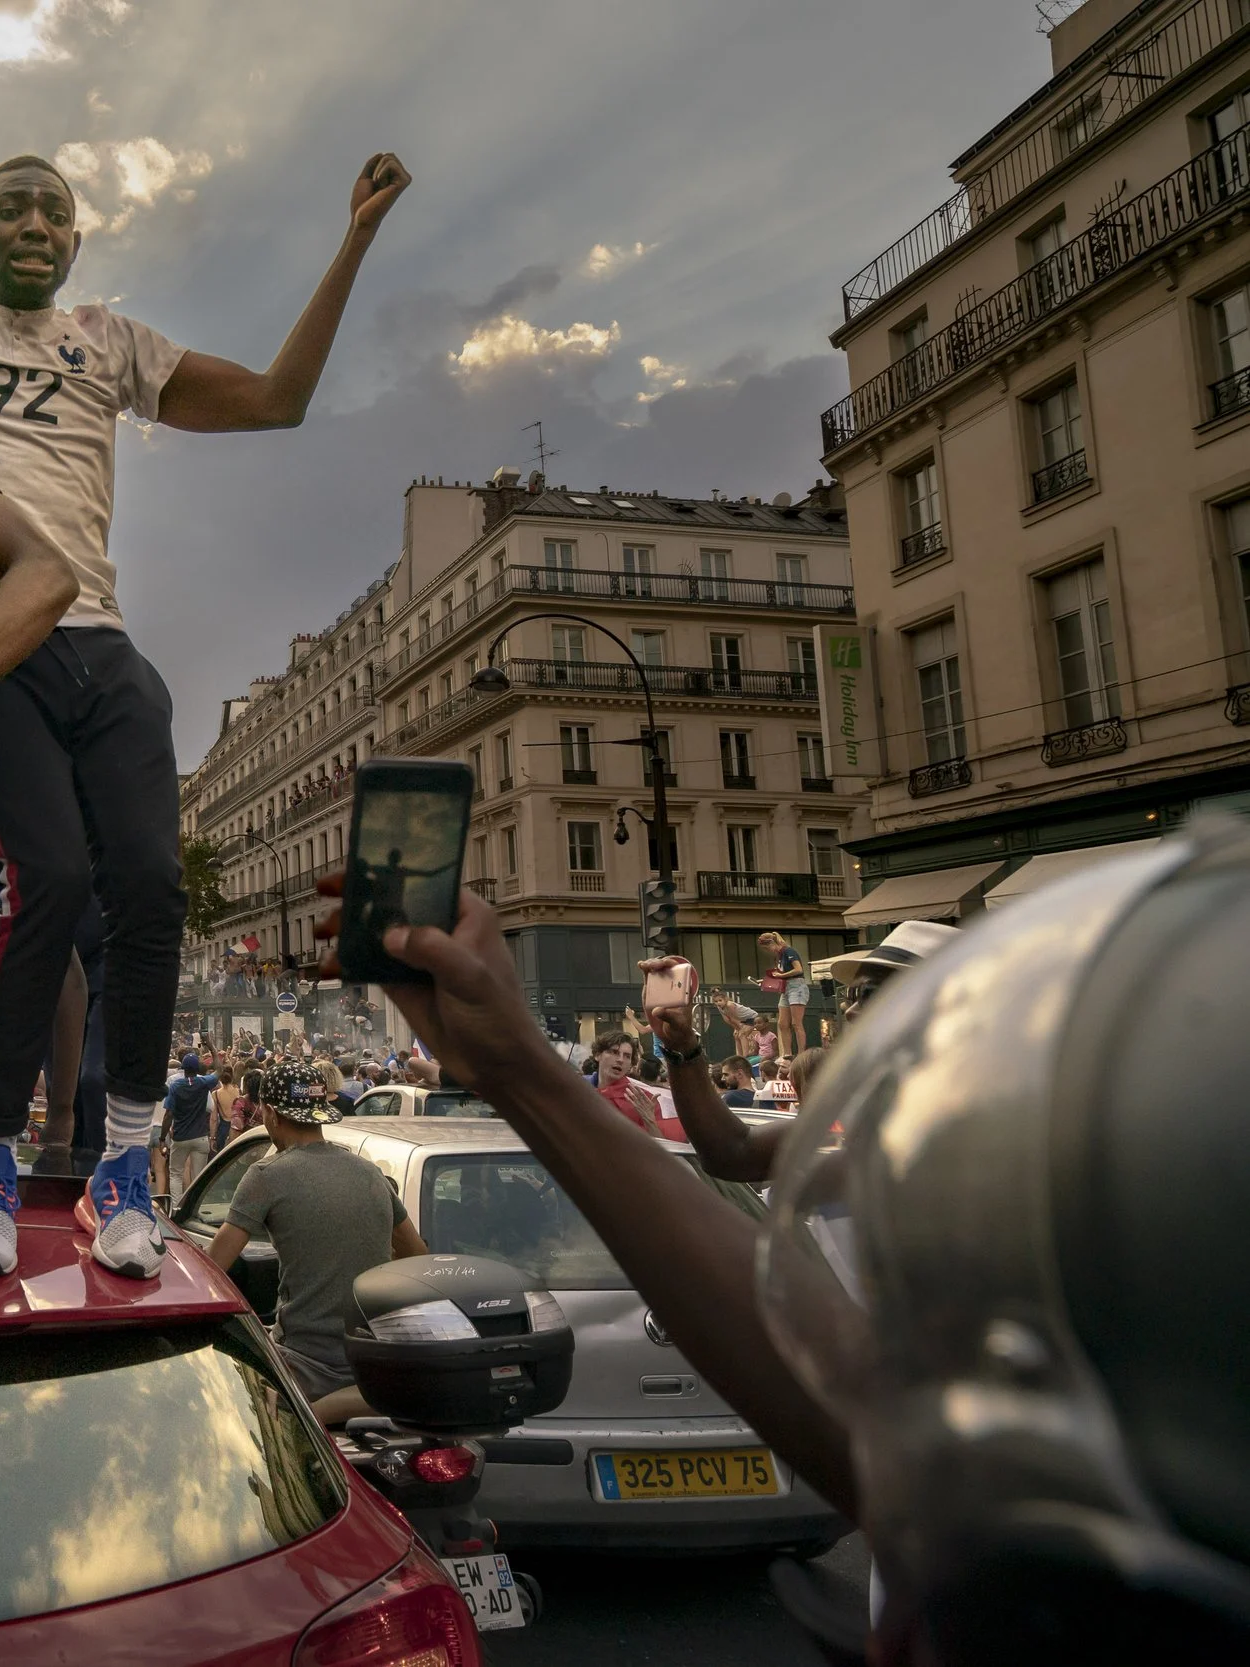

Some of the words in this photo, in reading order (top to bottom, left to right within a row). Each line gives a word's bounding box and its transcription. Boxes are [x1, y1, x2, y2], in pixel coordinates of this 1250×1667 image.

[840, 674, 859, 737] Holiday
[846, 740, 862, 767] Inn
[774, 1082, 794, 1093] TAX
[620, 1458, 674, 1489] 325
[678, 1456, 727, 1487] PCV
[733, 1456, 770, 1486] 75
[606, 1480, 613, 1490] F
[499, 1572, 511, 1585] 92
